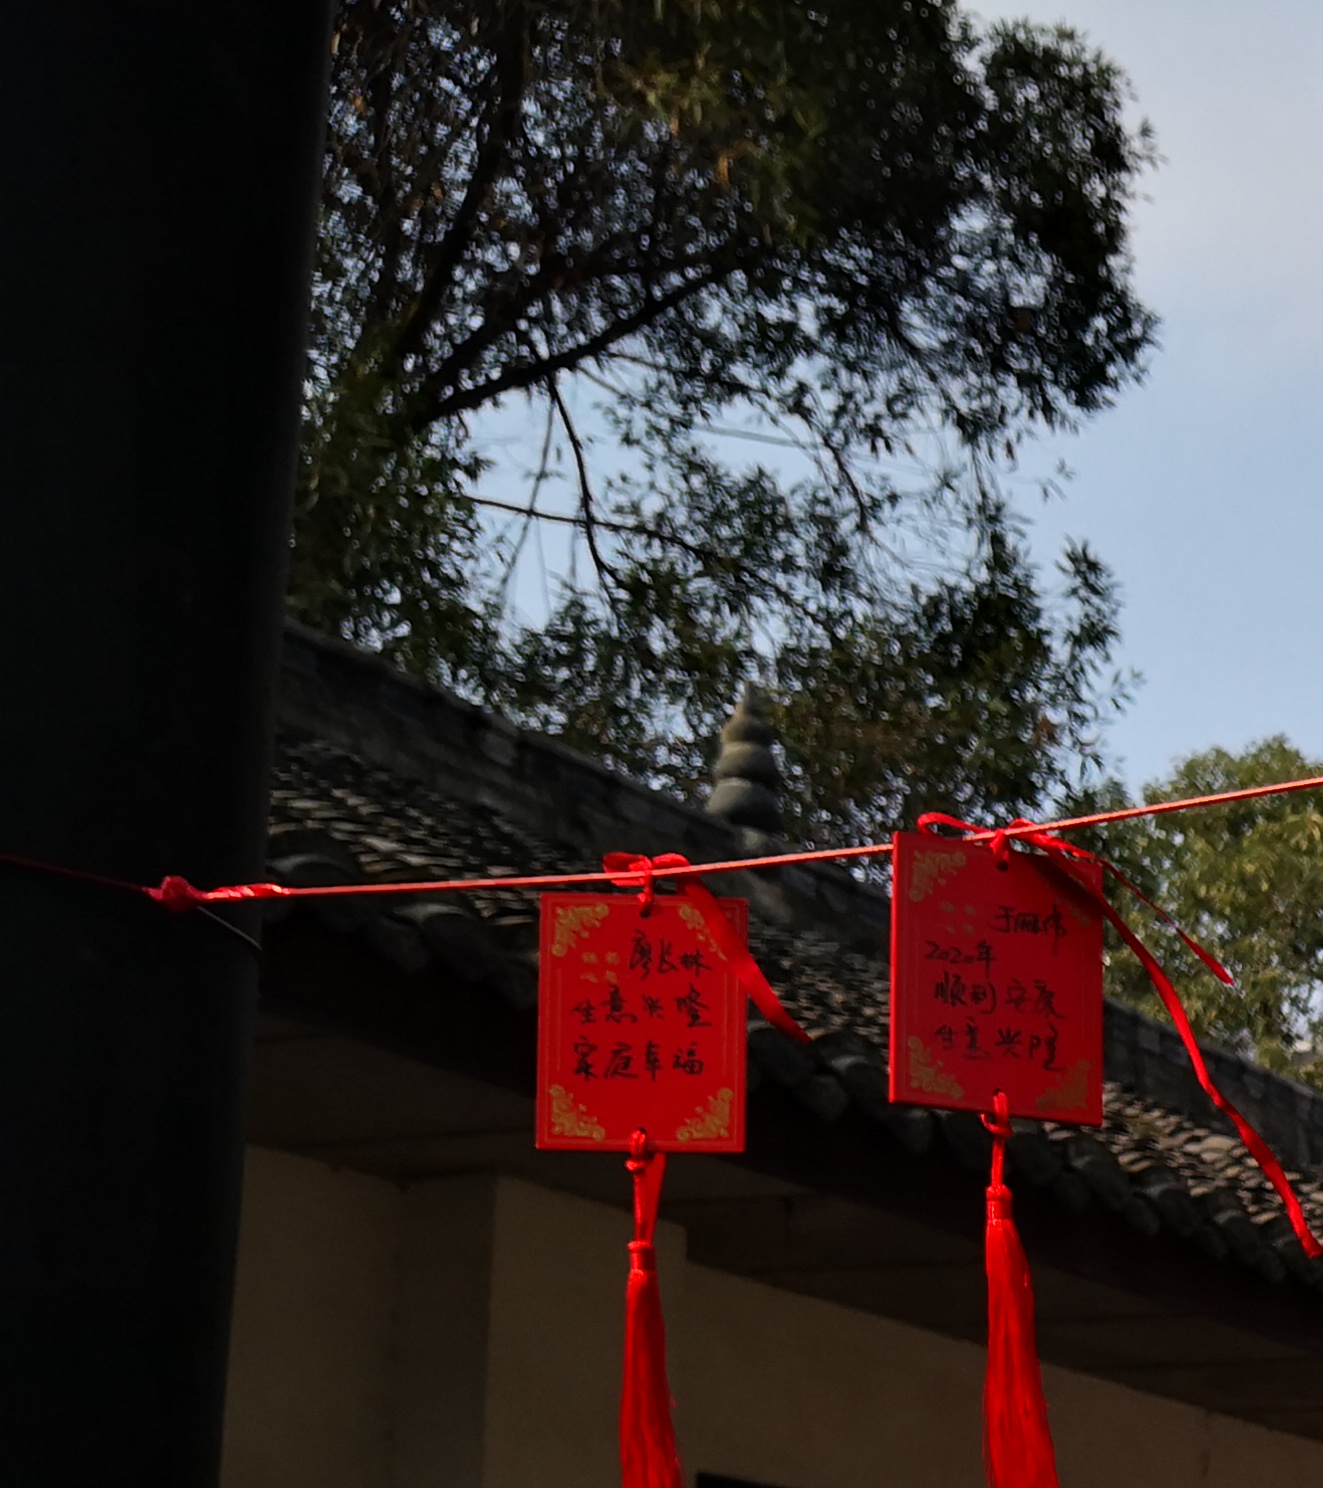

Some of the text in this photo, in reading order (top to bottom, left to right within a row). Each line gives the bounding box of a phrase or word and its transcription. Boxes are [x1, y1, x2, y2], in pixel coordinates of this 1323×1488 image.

[573, 983, 713, 1028] 生意兴隆
[573, 1036, 704, 1082] 家庭幸福
